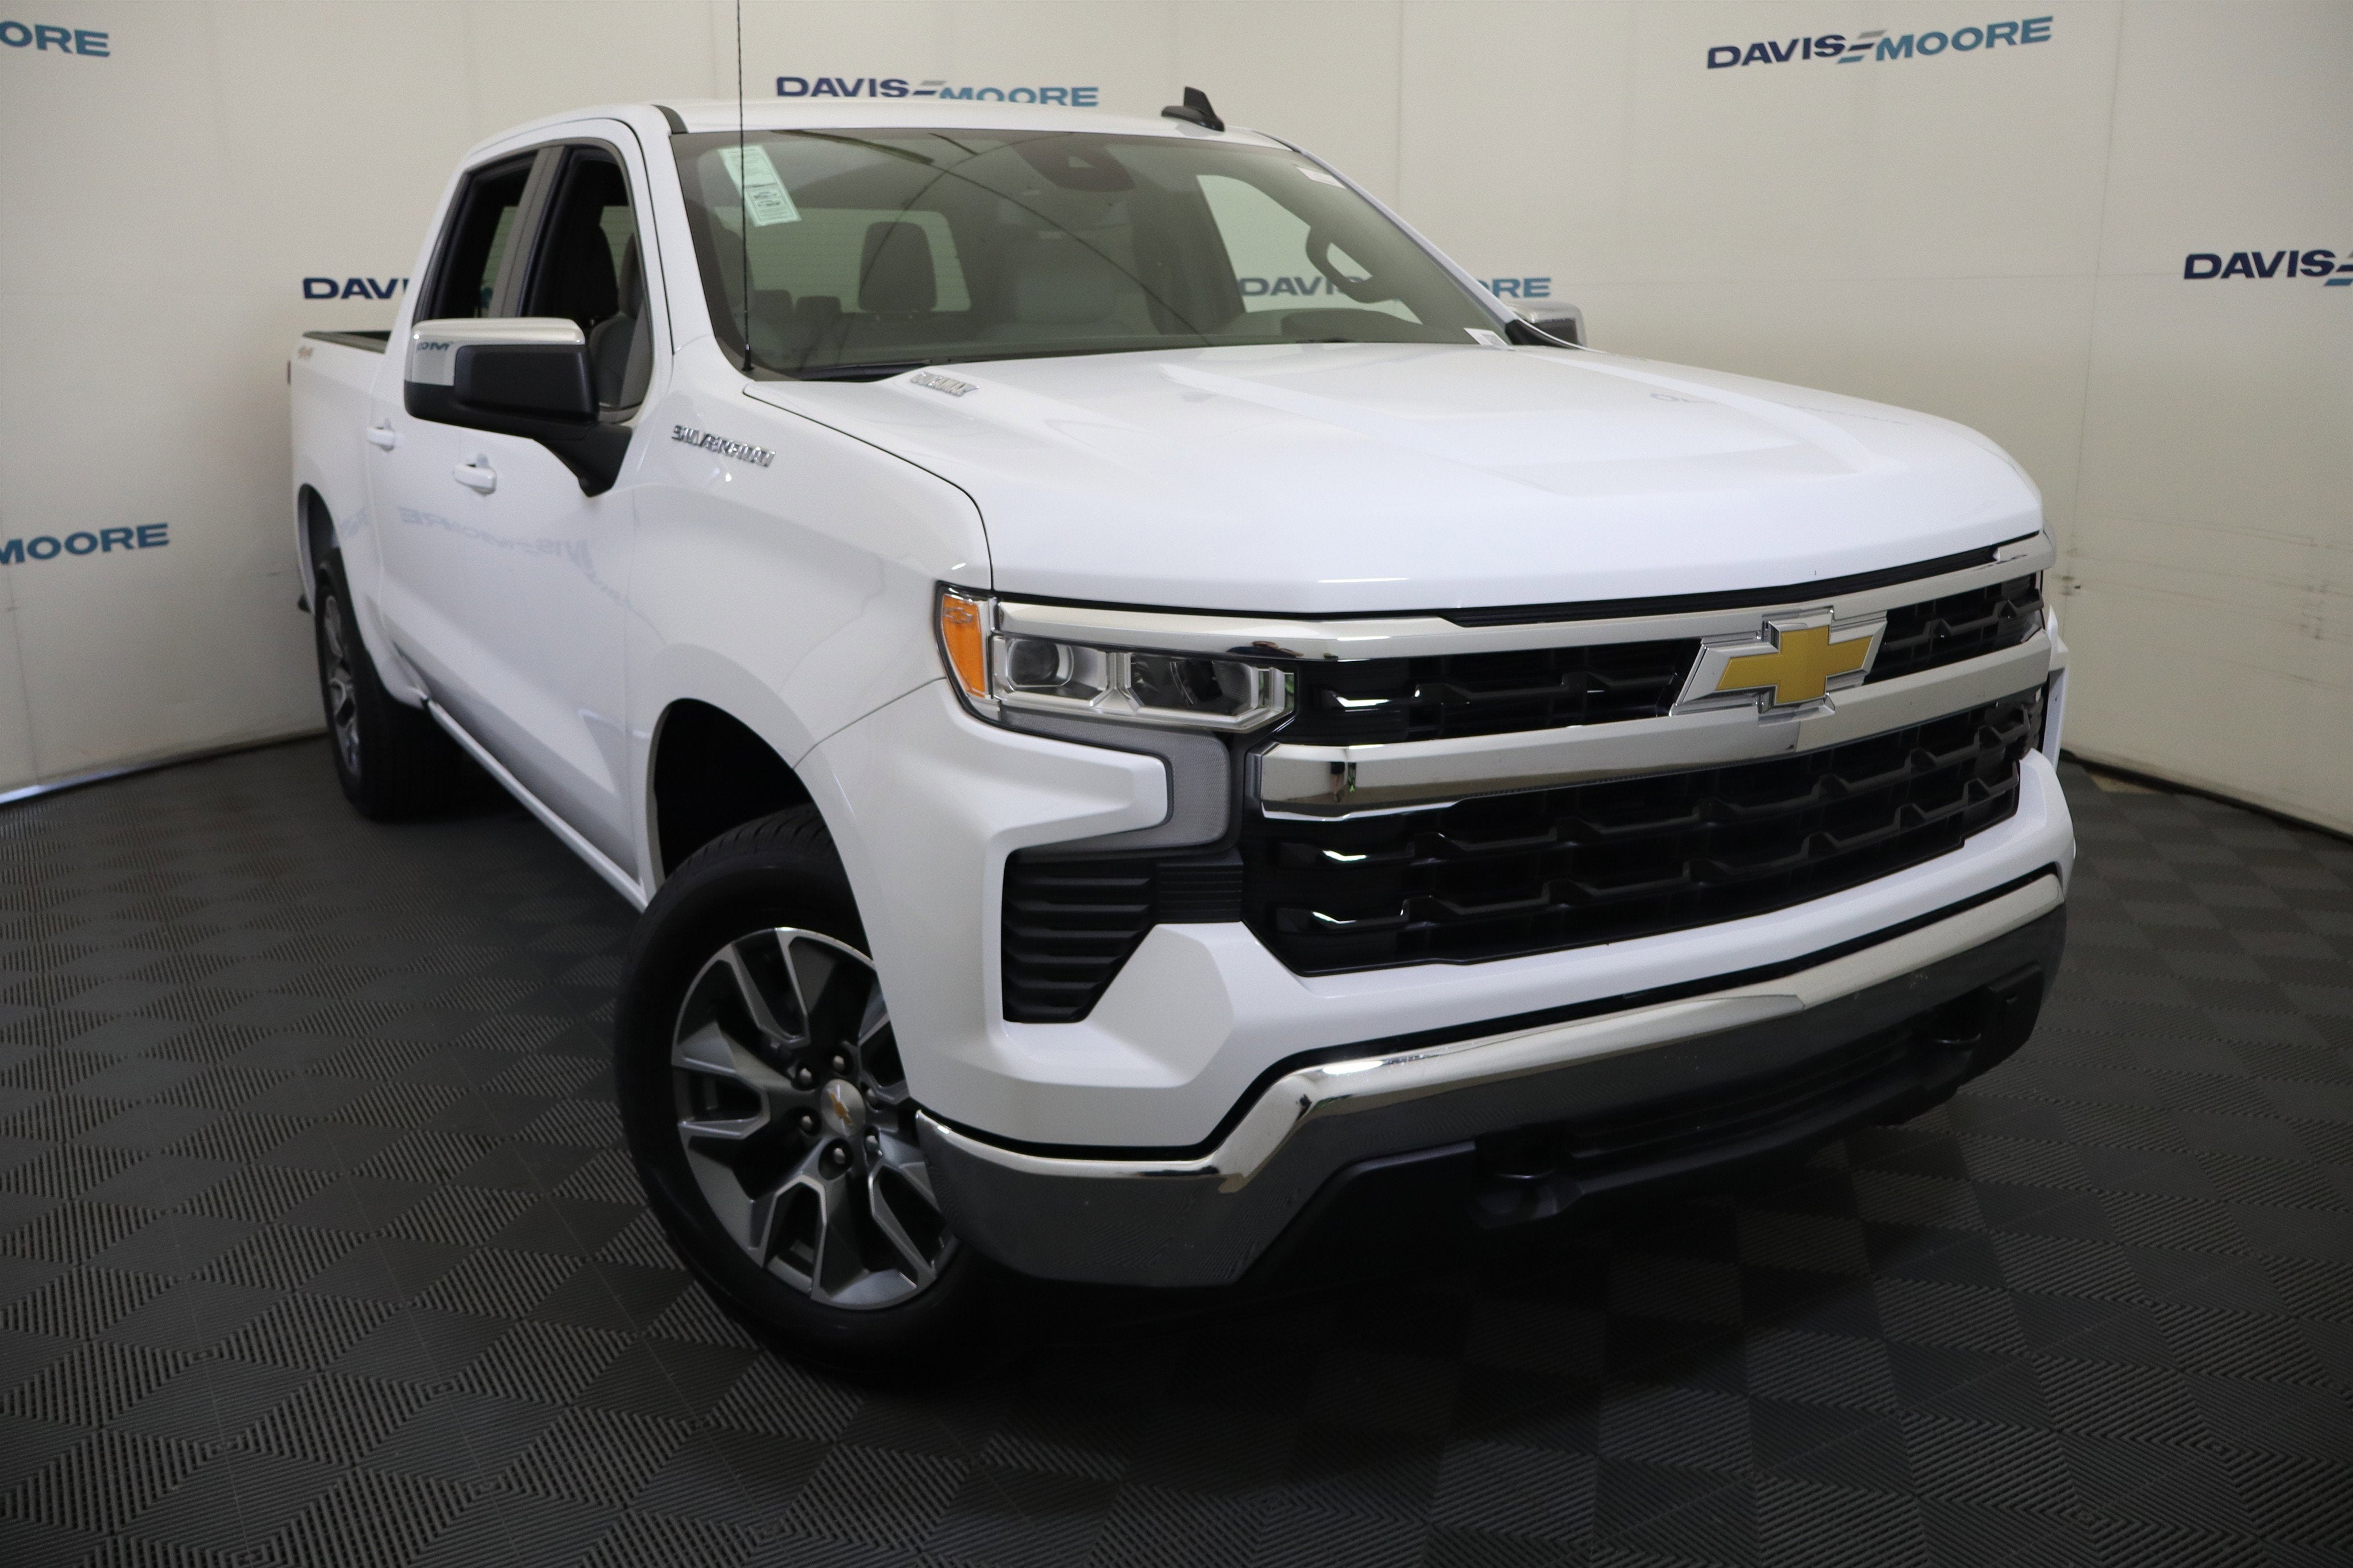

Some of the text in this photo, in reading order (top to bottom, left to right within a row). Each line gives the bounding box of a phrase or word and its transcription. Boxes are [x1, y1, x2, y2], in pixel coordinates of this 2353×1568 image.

[0, 21, 111, 57] ORE
[1707, 16, 2053, 69] DAVIS MOORE
[777, 76, 1099, 107] DAVIS MOORE
[2184, 249, 2336, 280] DAVIS
[1238, 276, 1551, 298] DAVI RE
[0, 522, 170, 565] MOORE
